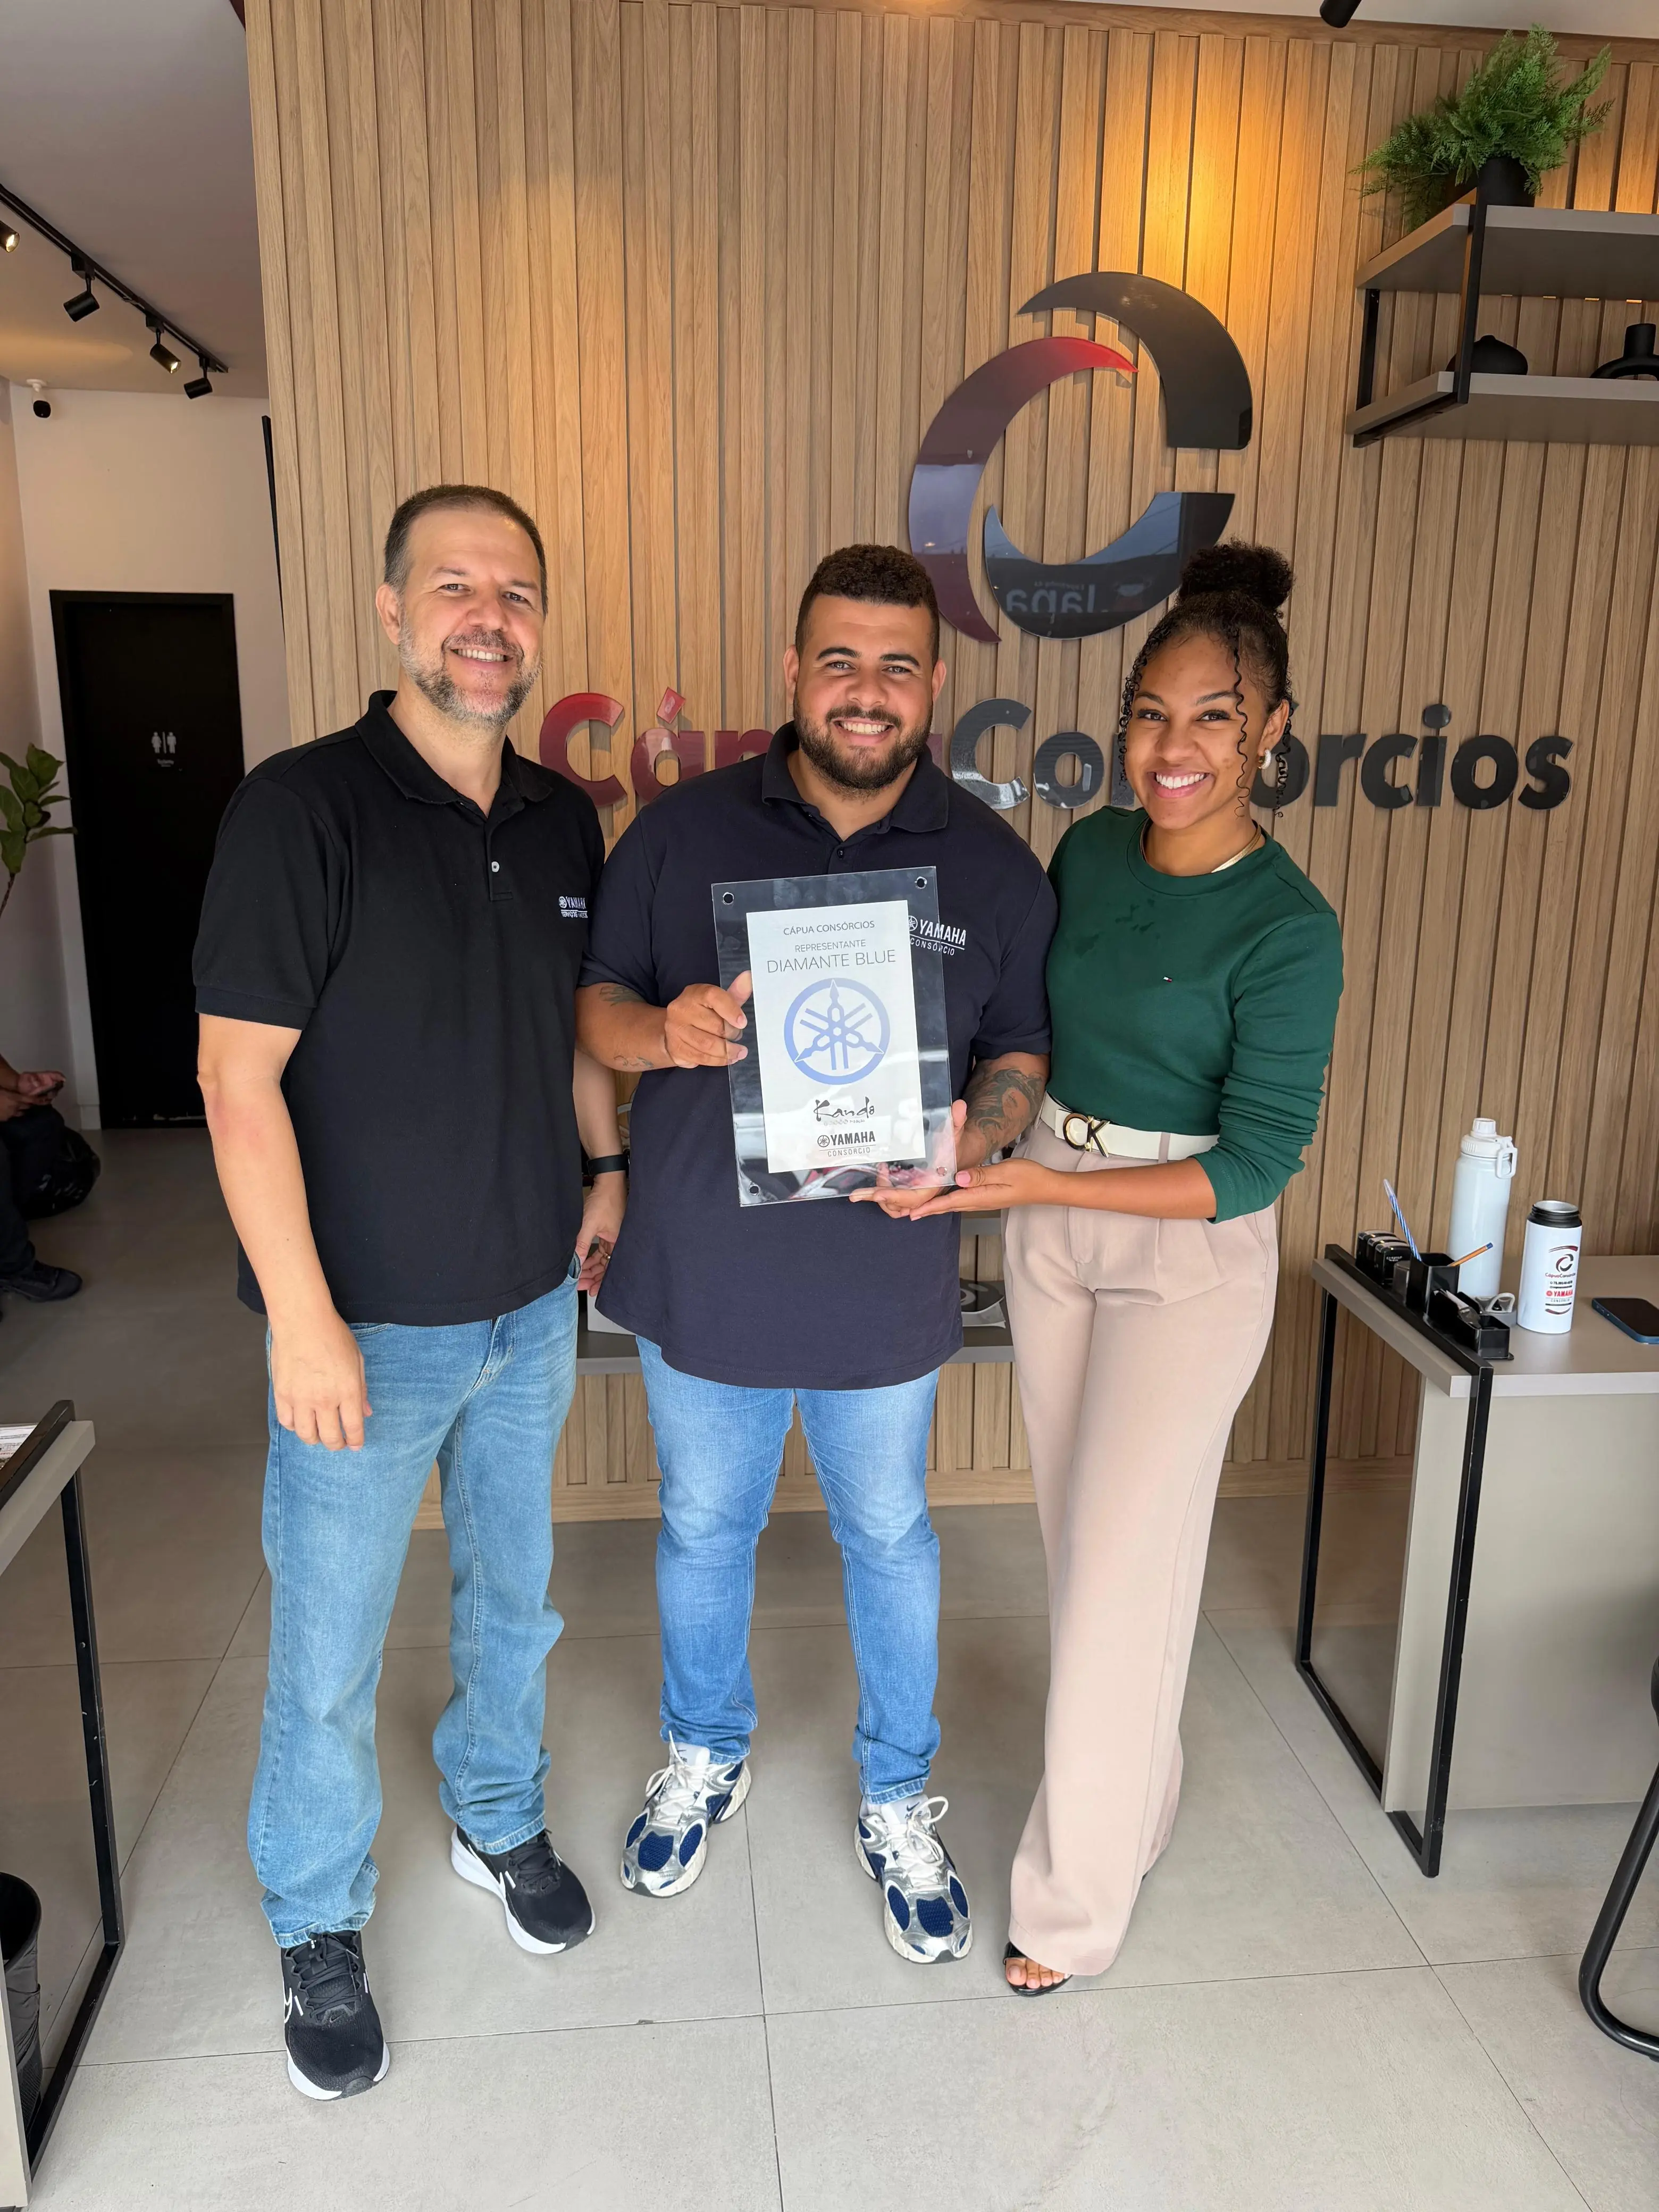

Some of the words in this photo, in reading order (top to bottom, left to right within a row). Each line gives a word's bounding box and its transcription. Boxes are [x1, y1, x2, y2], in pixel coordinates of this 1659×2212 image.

[783, 926, 815, 935] CÁPUA
[816, 920, 875, 933] CONSÓRCIOS
[920, 919, 966, 945] YAMAHA
[795, 939, 866, 952] REPRESENTANTE
[767, 953, 850, 973] DIAMANTE
[856, 949, 896, 965] BLUE
[814, 1096, 875, 1121] Kando
[831, 1131, 876, 1145] YAMAHA
[828, 1147, 870, 1157] CONSORCIO
